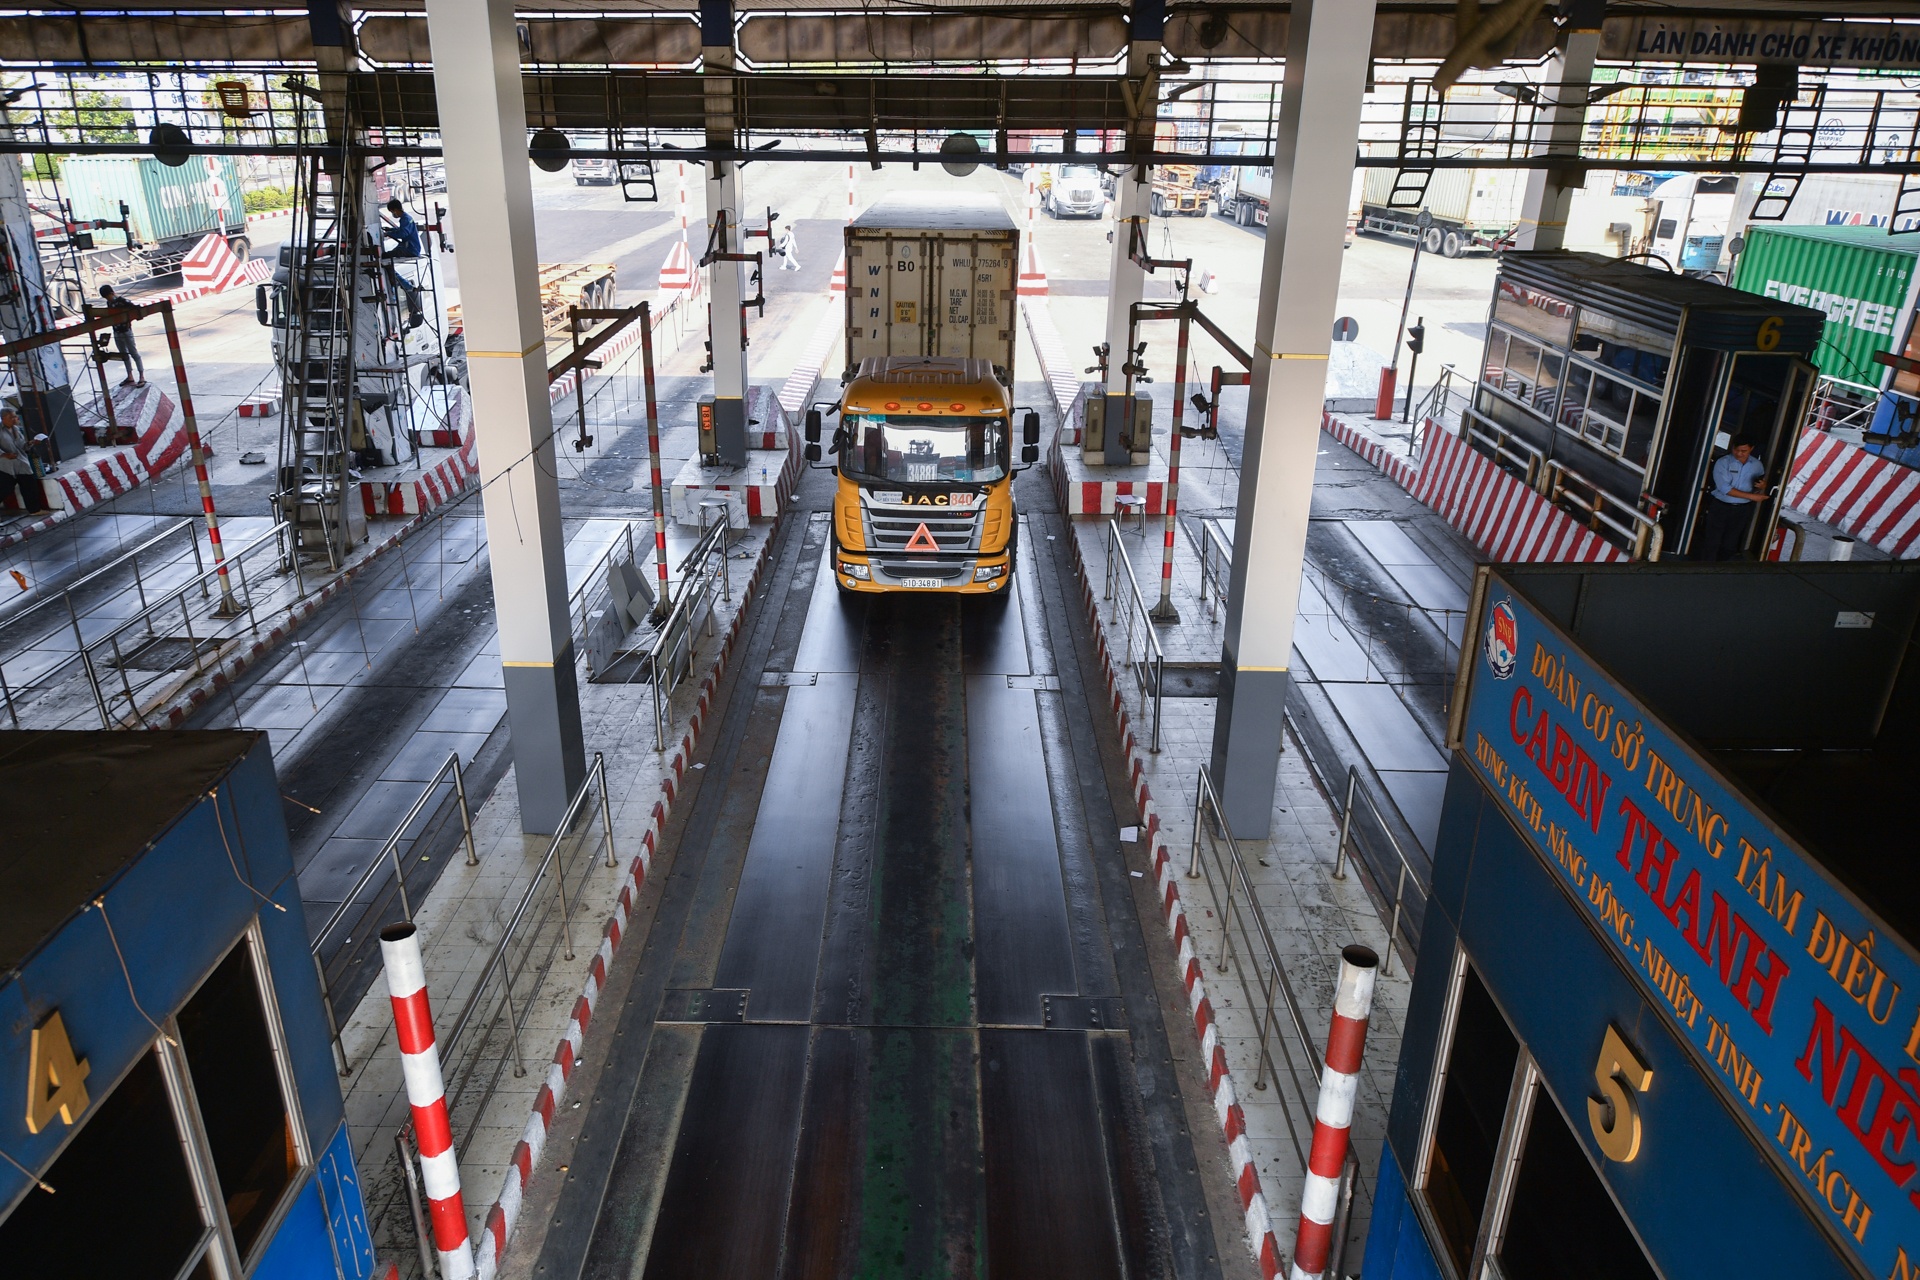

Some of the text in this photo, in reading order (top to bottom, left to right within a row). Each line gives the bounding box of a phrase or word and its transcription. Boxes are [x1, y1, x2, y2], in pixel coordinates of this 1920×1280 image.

[1637, 24, 1686, 54] LÀN
[1690, 26, 1756, 57] DÀNH
[1760, 34, 1810, 59] CHO
[1813, 36, 1846, 60] XE
[949, 306, 959, 315] NET
[950, 298, 963, 306] TARE
[1756, 316, 1784, 352] 6
[908, 464, 936, 482] 34881
[901, 495, 948, 505] JAC
[951, 494, 973, 506] 840
[1498, 616, 1512, 644] SNP
[1531, 641, 1901, 1025] ĐOÀN CƠ SỞ TRUNG TÂM ĐIỀU
[1510, 686, 1920, 1214] CABIN THANH NIÊ
[1475, 731, 1509, 788] XUNG
[1546, 820, 1587, 887] NĂNG
[1587, 871, 1635, 947] ĐỘNG
[1640, 936, 1704, 1031] NHIỆT
[1705, 1014, 1764, 1109] TÌNH
[1775, 1102, 1874, 1245] TRÁCH
[25, 1009, 92, 1135] 4
[1587, 1024, 1653, 1163] 5
